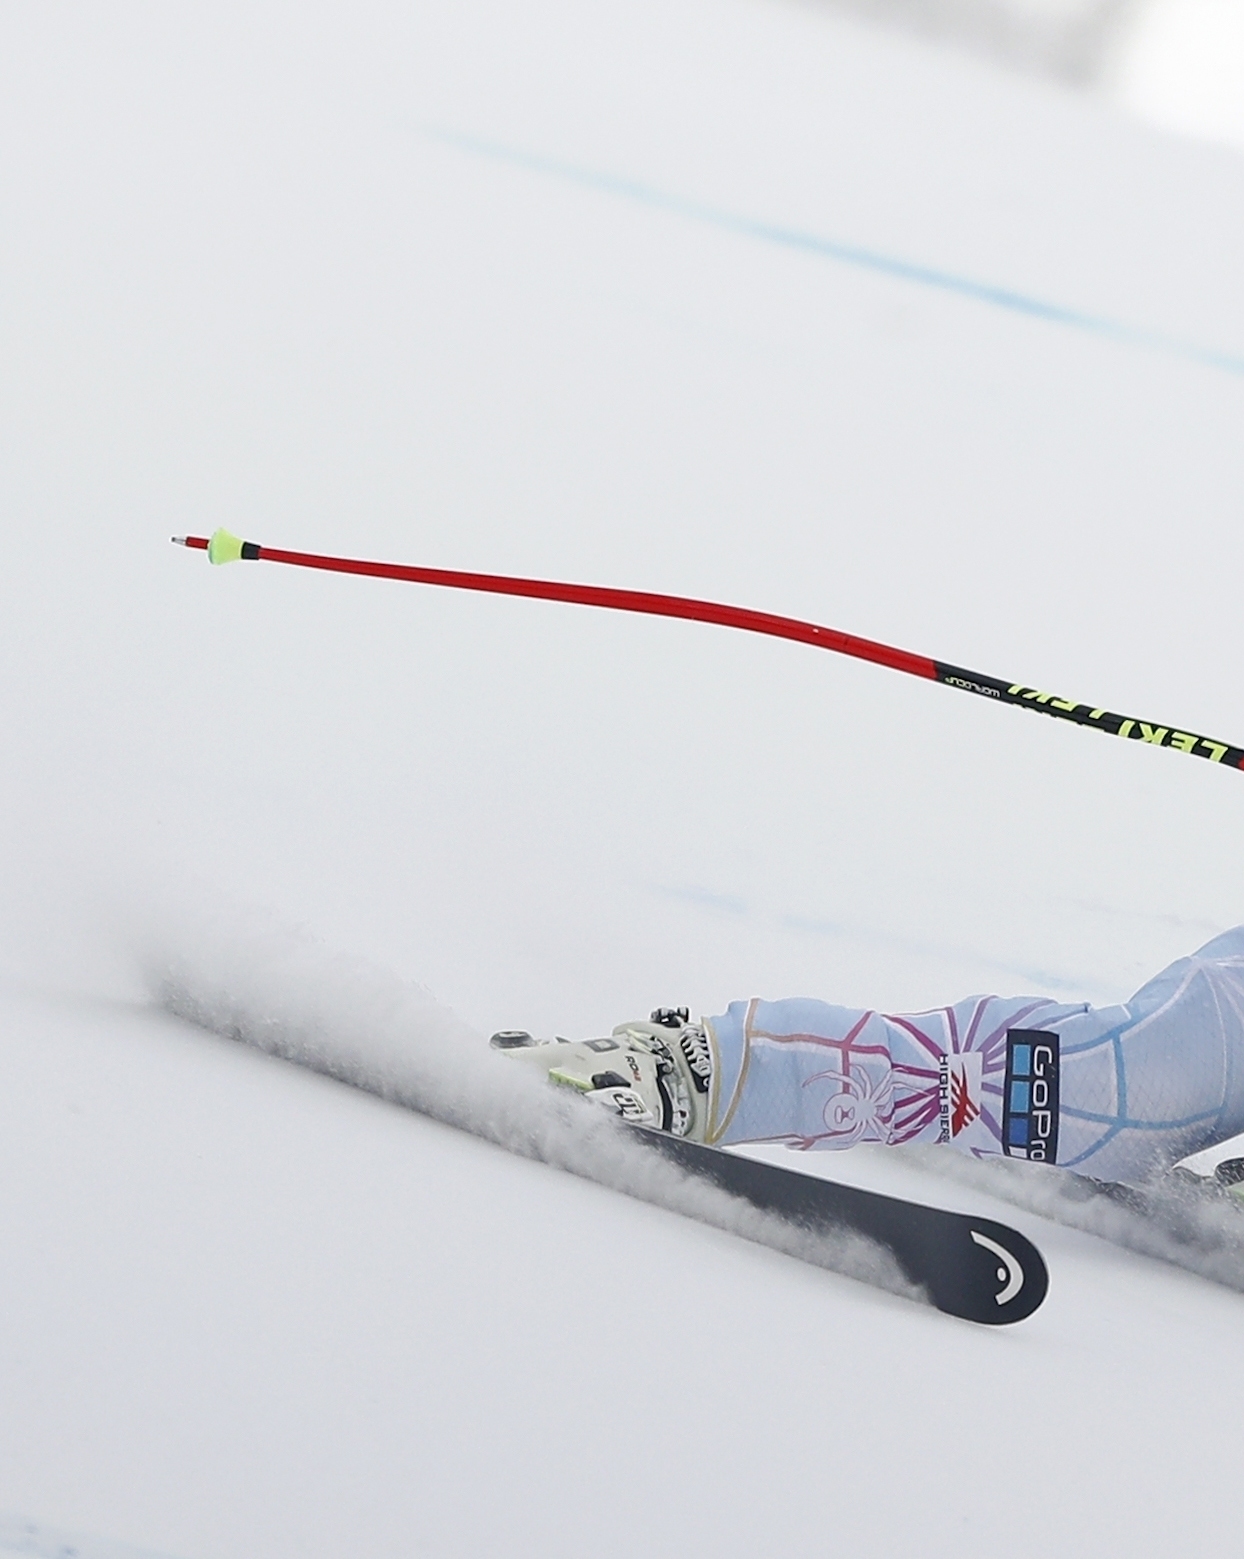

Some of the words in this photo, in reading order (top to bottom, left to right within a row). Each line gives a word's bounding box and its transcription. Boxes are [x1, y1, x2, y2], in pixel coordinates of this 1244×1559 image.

[1117, 719, 1229, 763] LEKI
[939, 1053, 949, 1099] HIGH
[1030, 1045, 1053, 1161] GoPro
